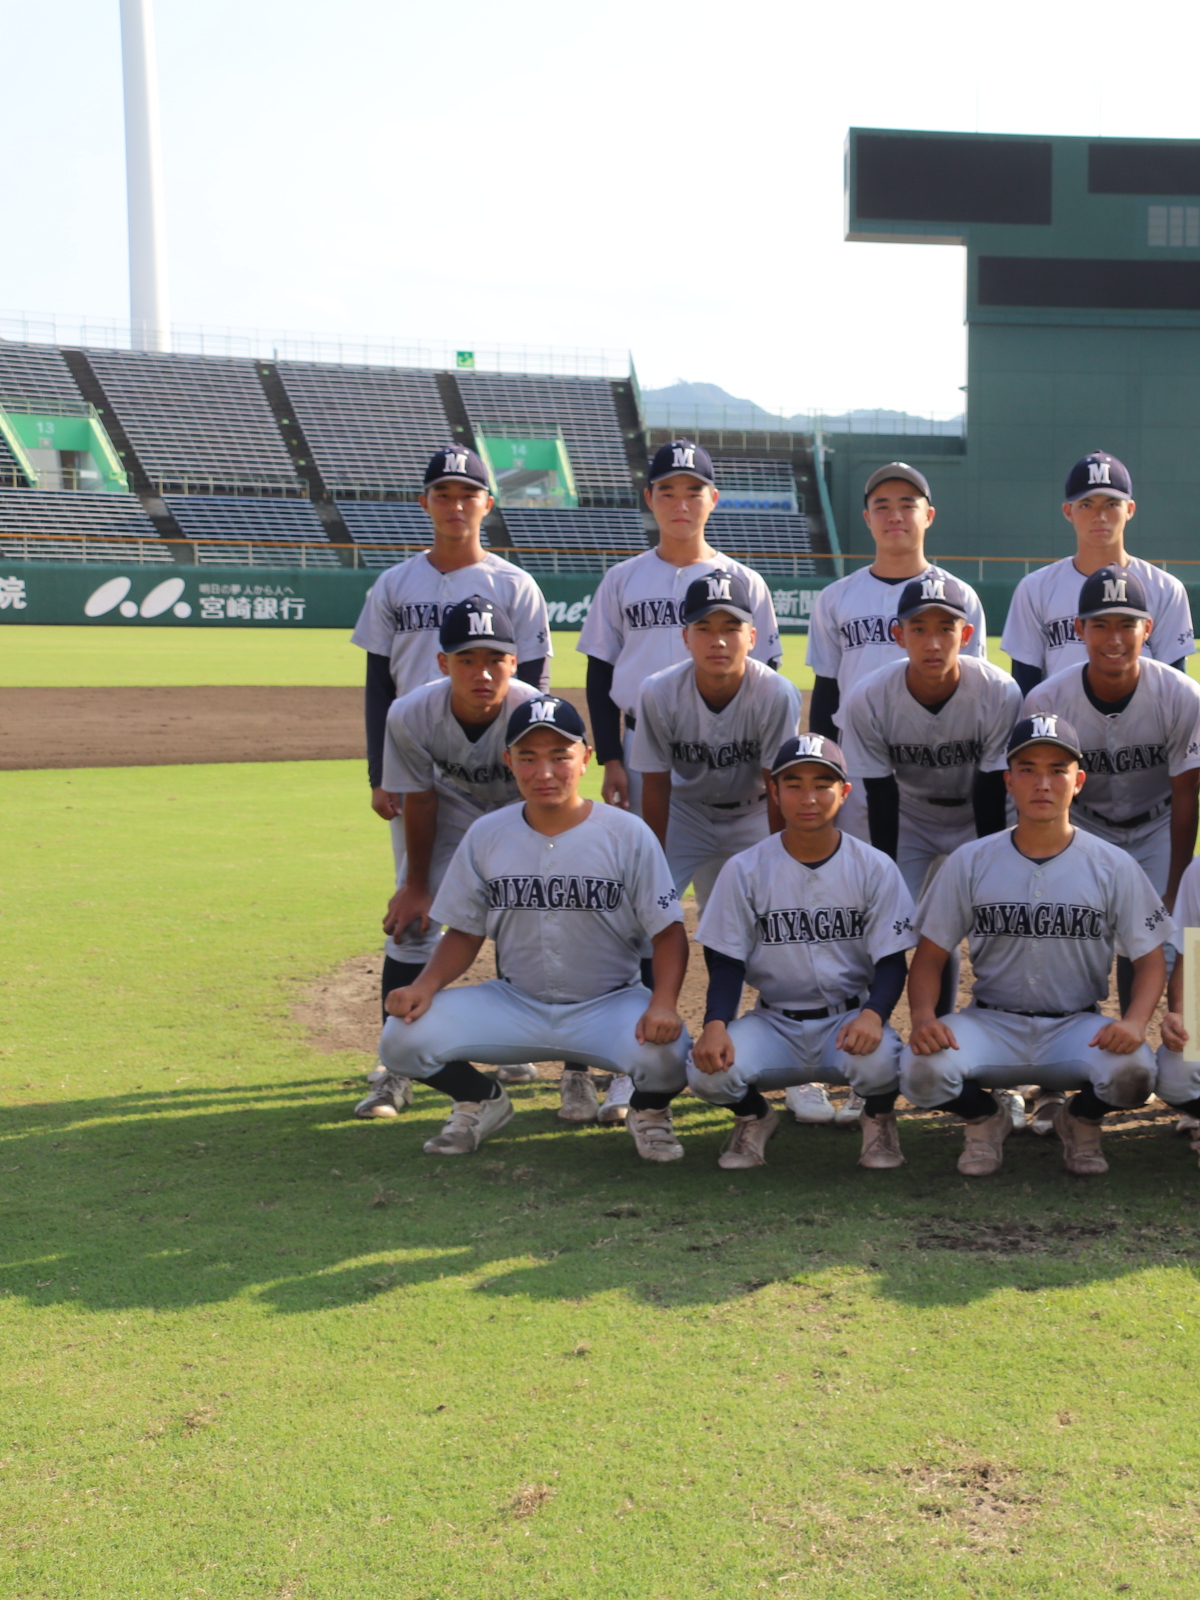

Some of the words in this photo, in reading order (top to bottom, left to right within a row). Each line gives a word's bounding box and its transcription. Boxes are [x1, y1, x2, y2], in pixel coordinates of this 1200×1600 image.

[37, 422, 55, 434] 13
[511, 445, 527, 456] 14
[672, 448, 696, 469] M
[443, 453, 467, 474] M
[1088, 463, 1111, 485] M
[707, 579, 733, 601] M
[921, 578, 947, 600] M
[1102, 580, 1128, 602] M
[199, 597, 307, 620] 宮崎銀行
[468, 612, 495, 636] M
[528, 701, 556, 724] M
[1031, 716, 1058, 738] M
[795, 735, 825, 758] M
